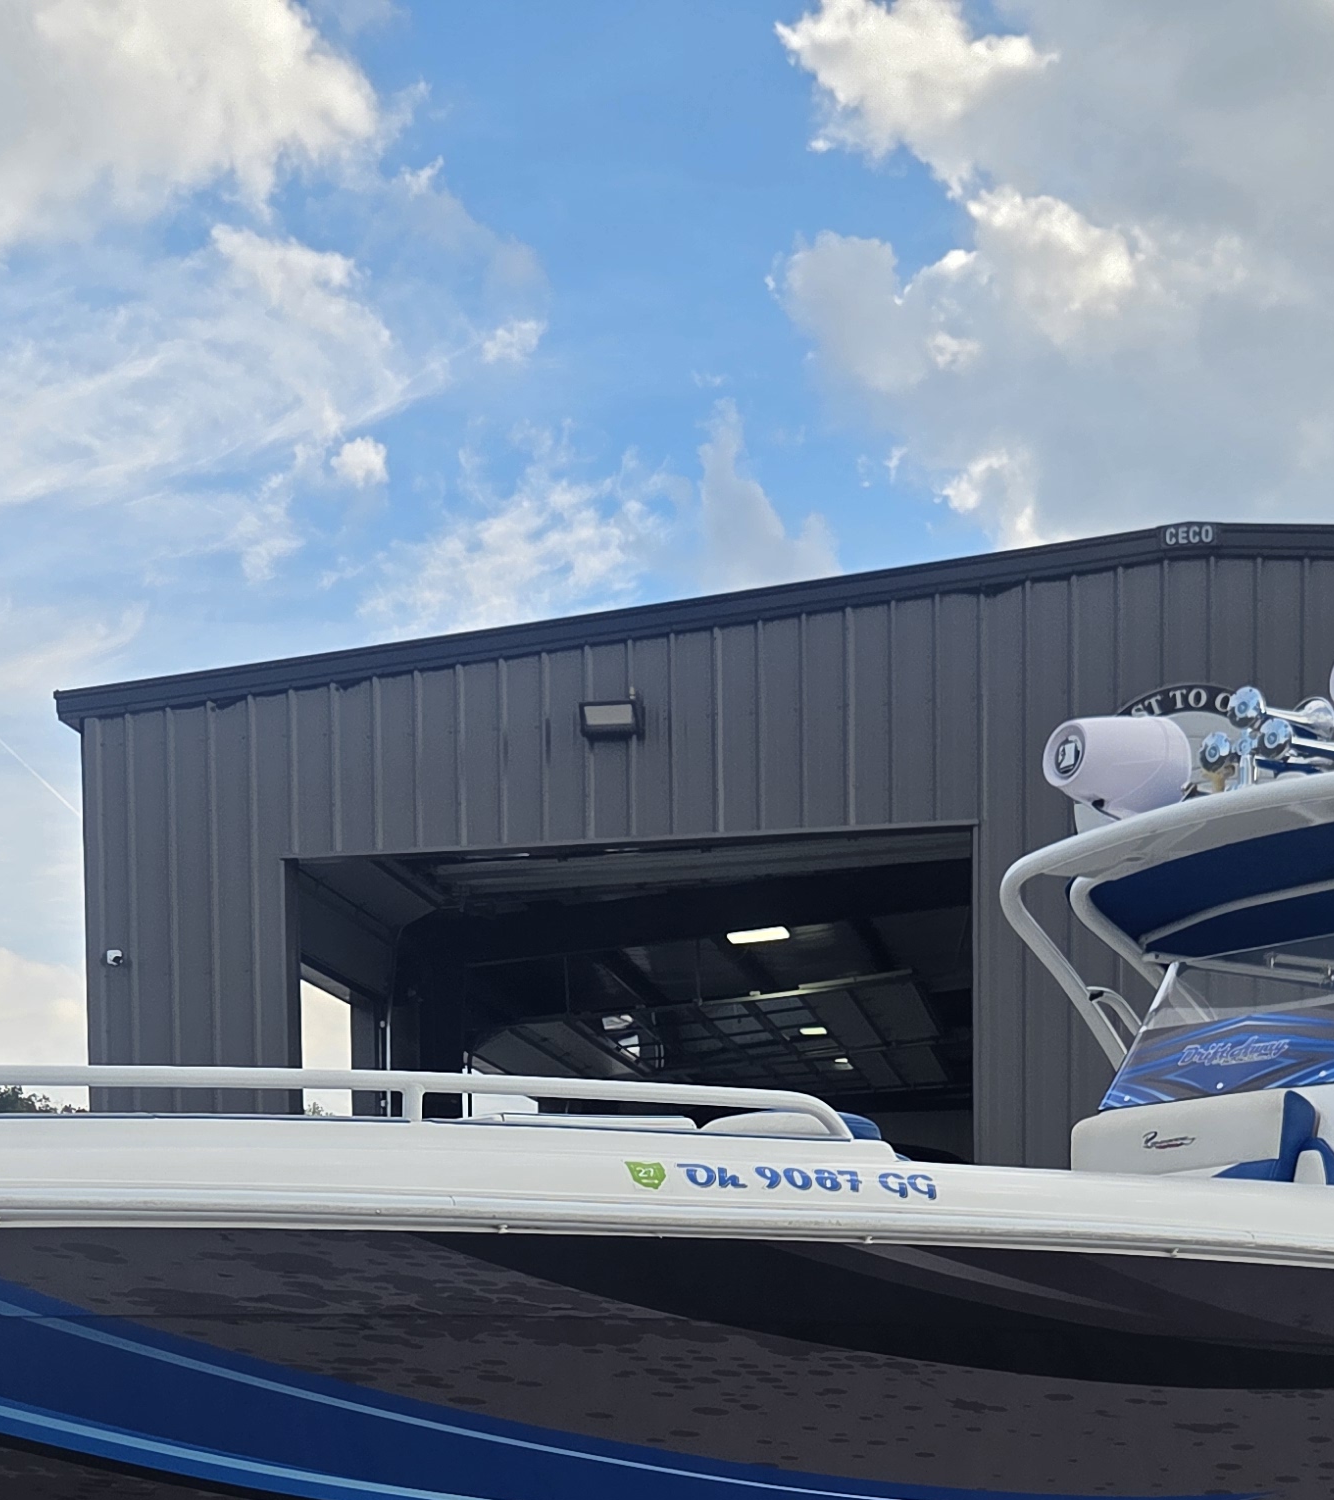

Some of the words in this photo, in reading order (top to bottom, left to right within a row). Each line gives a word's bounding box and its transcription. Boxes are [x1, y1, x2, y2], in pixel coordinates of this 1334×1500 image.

[1165, 525, 1213, 545] CECO
[1169, 688, 1207, 710] TO
[755, 1166, 863, 1193] 9087
[878, 1172, 937, 1200] GG
